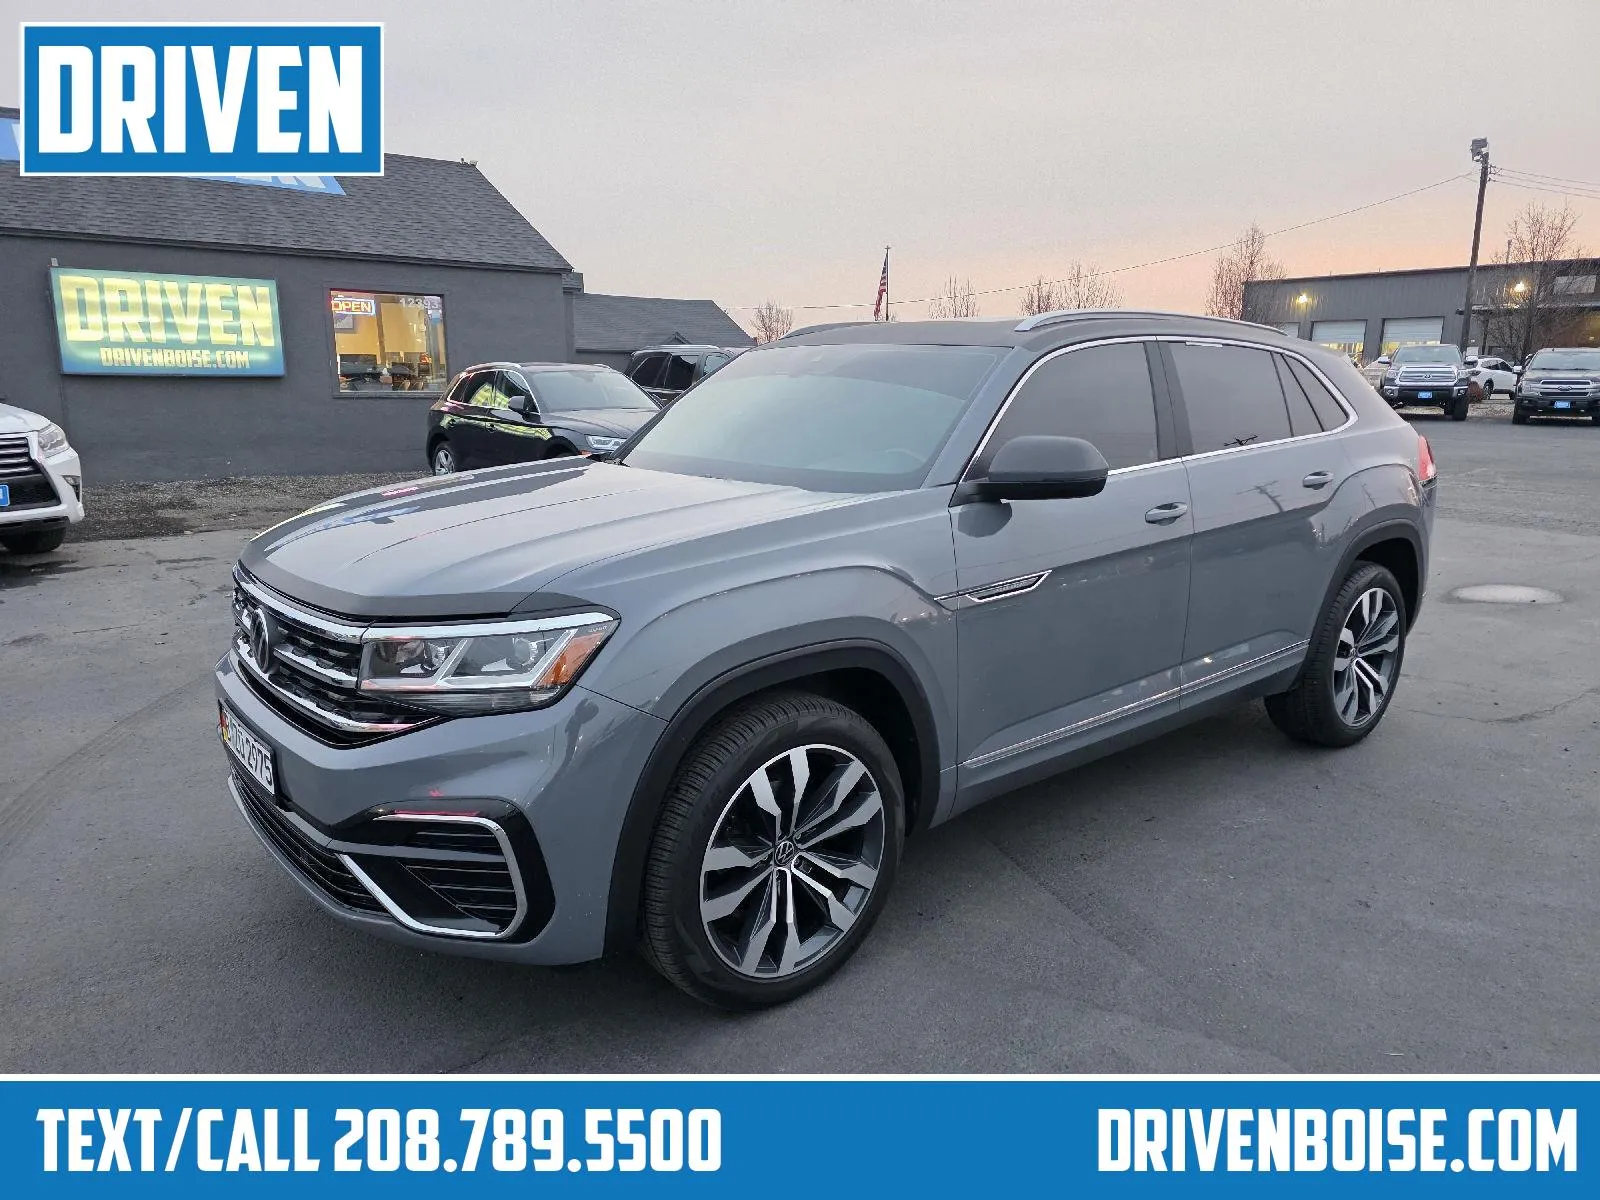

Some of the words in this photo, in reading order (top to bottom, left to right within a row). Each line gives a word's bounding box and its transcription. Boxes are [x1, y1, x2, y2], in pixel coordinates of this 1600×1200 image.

[60, 275, 275, 347] DRIVEN
[332, 301, 371, 312] OPEN
[100, 347, 250, 369] DRIVENBOISE.COM
[245, 736, 273, 787] 2975
